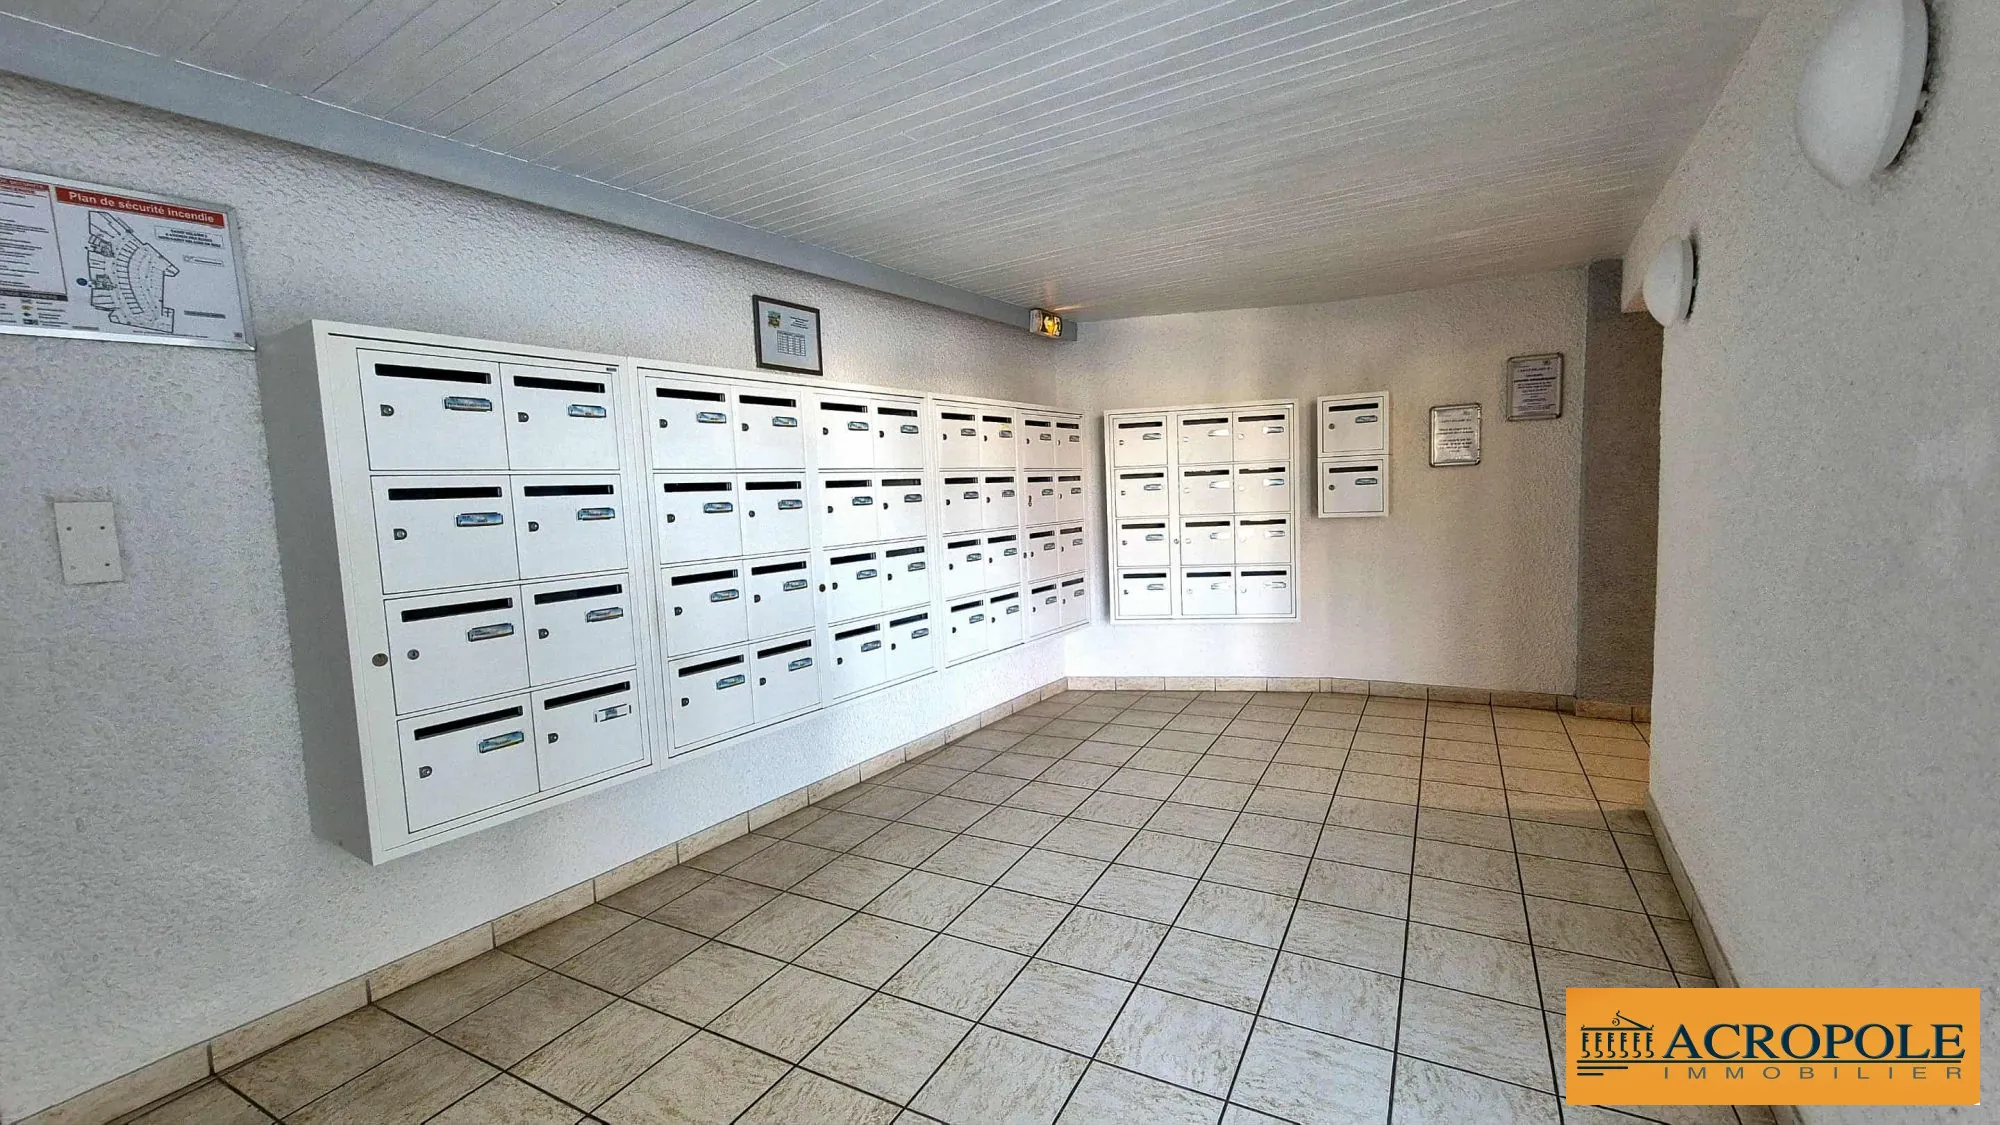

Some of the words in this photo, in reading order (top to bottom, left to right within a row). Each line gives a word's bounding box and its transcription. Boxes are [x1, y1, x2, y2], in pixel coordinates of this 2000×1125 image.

[69, 192, 97, 204] Plan
[100, 197, 116, 208] de
[118, 200, 165, 215] sécurité
[168, 208, 215, 223] incendie
